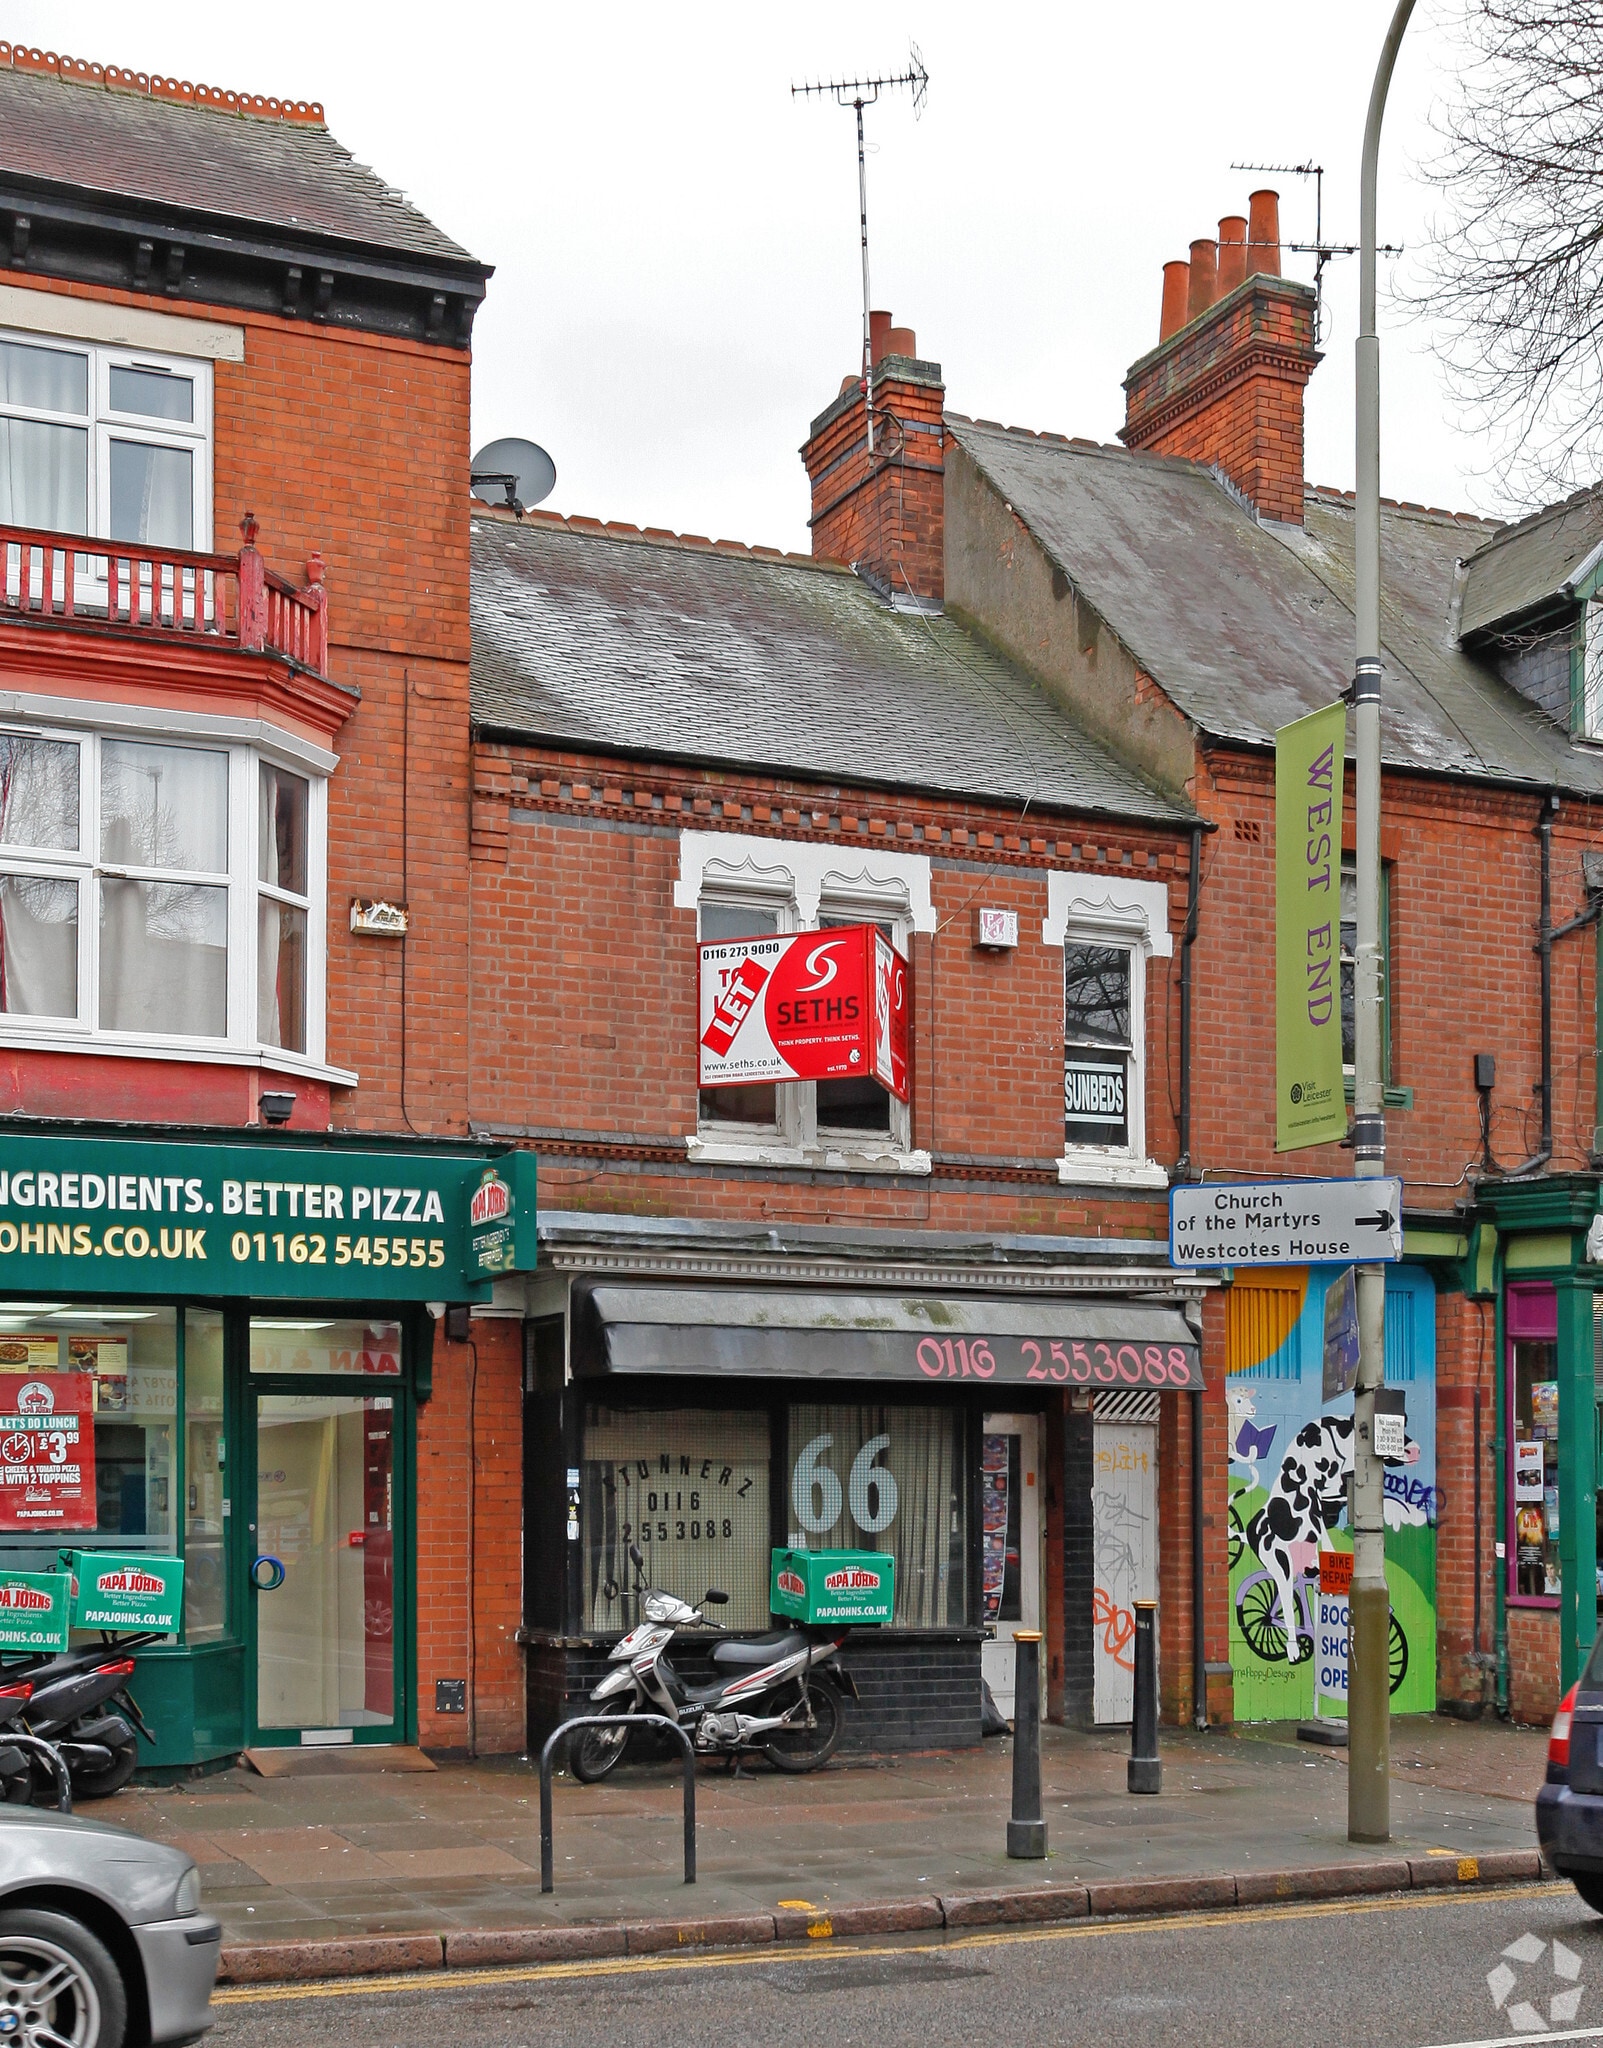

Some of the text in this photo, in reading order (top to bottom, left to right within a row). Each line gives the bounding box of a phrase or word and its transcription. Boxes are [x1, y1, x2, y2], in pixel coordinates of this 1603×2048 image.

[1306, 741, 1335, 1028] WEST END
[703, 942, 780, 961] 0116 273 9090
[712, 975, 757, 1038] LET
[777, 995, 860, 1025] SETHS
[778, 1034, 860, 1047] THINK PROPERTY. THINK SETHS.
[704, 1057, 782, 1071] www.seths.co.uk
[1064, 1072, 1124, 1114] SUNBEDS
[1302, 1080, 1316, 1092] Visit
[1302, 1088, 1332, 1102] Leicester
[222, 1179, 345, 1219] BETTER
[352, 1186, 445, 1223] PIZZA
[1214, 1192, 1283, 1211] Church
[1177, 1212, 1321, 1234] of the Martyrs
[231, 1230, 327, 1264] 01162
[334, 1234, 446, 1268] 545555
[1178, 1239, 1351, 1260] Westcotes House
[915, 1337, 1192, 1387] 0116 2553088
[0, 1417, 77, 1429] LET'S DO LUNCH
[5, 1464, 80, 1474] CHEESE & TOMATO PIZZA
[6, 1474, 29, 1484] WITH
[30, 1474, 37, 1484] 2
[38, 1473, 81, 1484] TOPPINGS
[791, 1432, 898, 1534] 66
[648, 1491, 701, 1512] 0116
[17, 1509, 64, 1518] PAPAJOHNS.CO.UK
[621, 1518, 733, 1544] 2553088
[1328, 1555, 1351, 1570] BIKE
[99, 1574, 164, 1594] PAPA JOHNS
[826, 1572, 879, 1588] PAPA JOHNS
[13, 1590, 51, 1610] JOHNS
[103, 1592, 157, 1602] Better Ingredients.
[112, 1599, 148, 1608] Better Pizza.
[85, 1610, 173, 1627] PAPAJOHNS.CO.UK
[816, 1605, 888, 1618] PAPAJOHNS.CO.UK
[16, 1617, 35, 1626] Pizza.
[678, 1703, 706, 1716] SUZUKI
